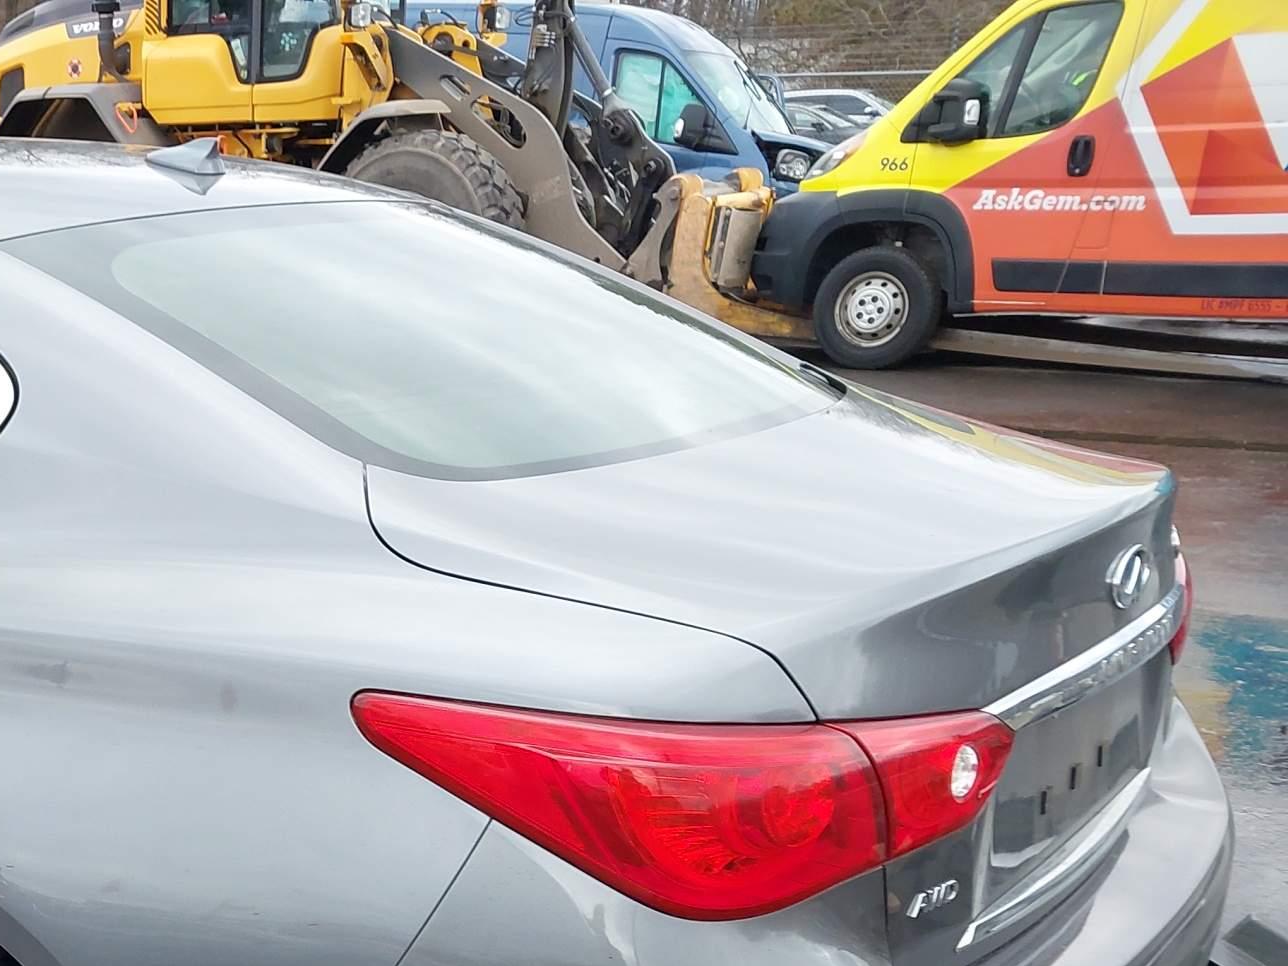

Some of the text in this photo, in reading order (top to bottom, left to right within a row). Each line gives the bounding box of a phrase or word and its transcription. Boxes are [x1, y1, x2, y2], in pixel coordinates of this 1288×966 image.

[72, 18, 124, 34] VOLO
[880, 157, 908, 171] 966
[972, 187, 1146, 211] AskGem.com
[905, 879, 960, 919] AWD
